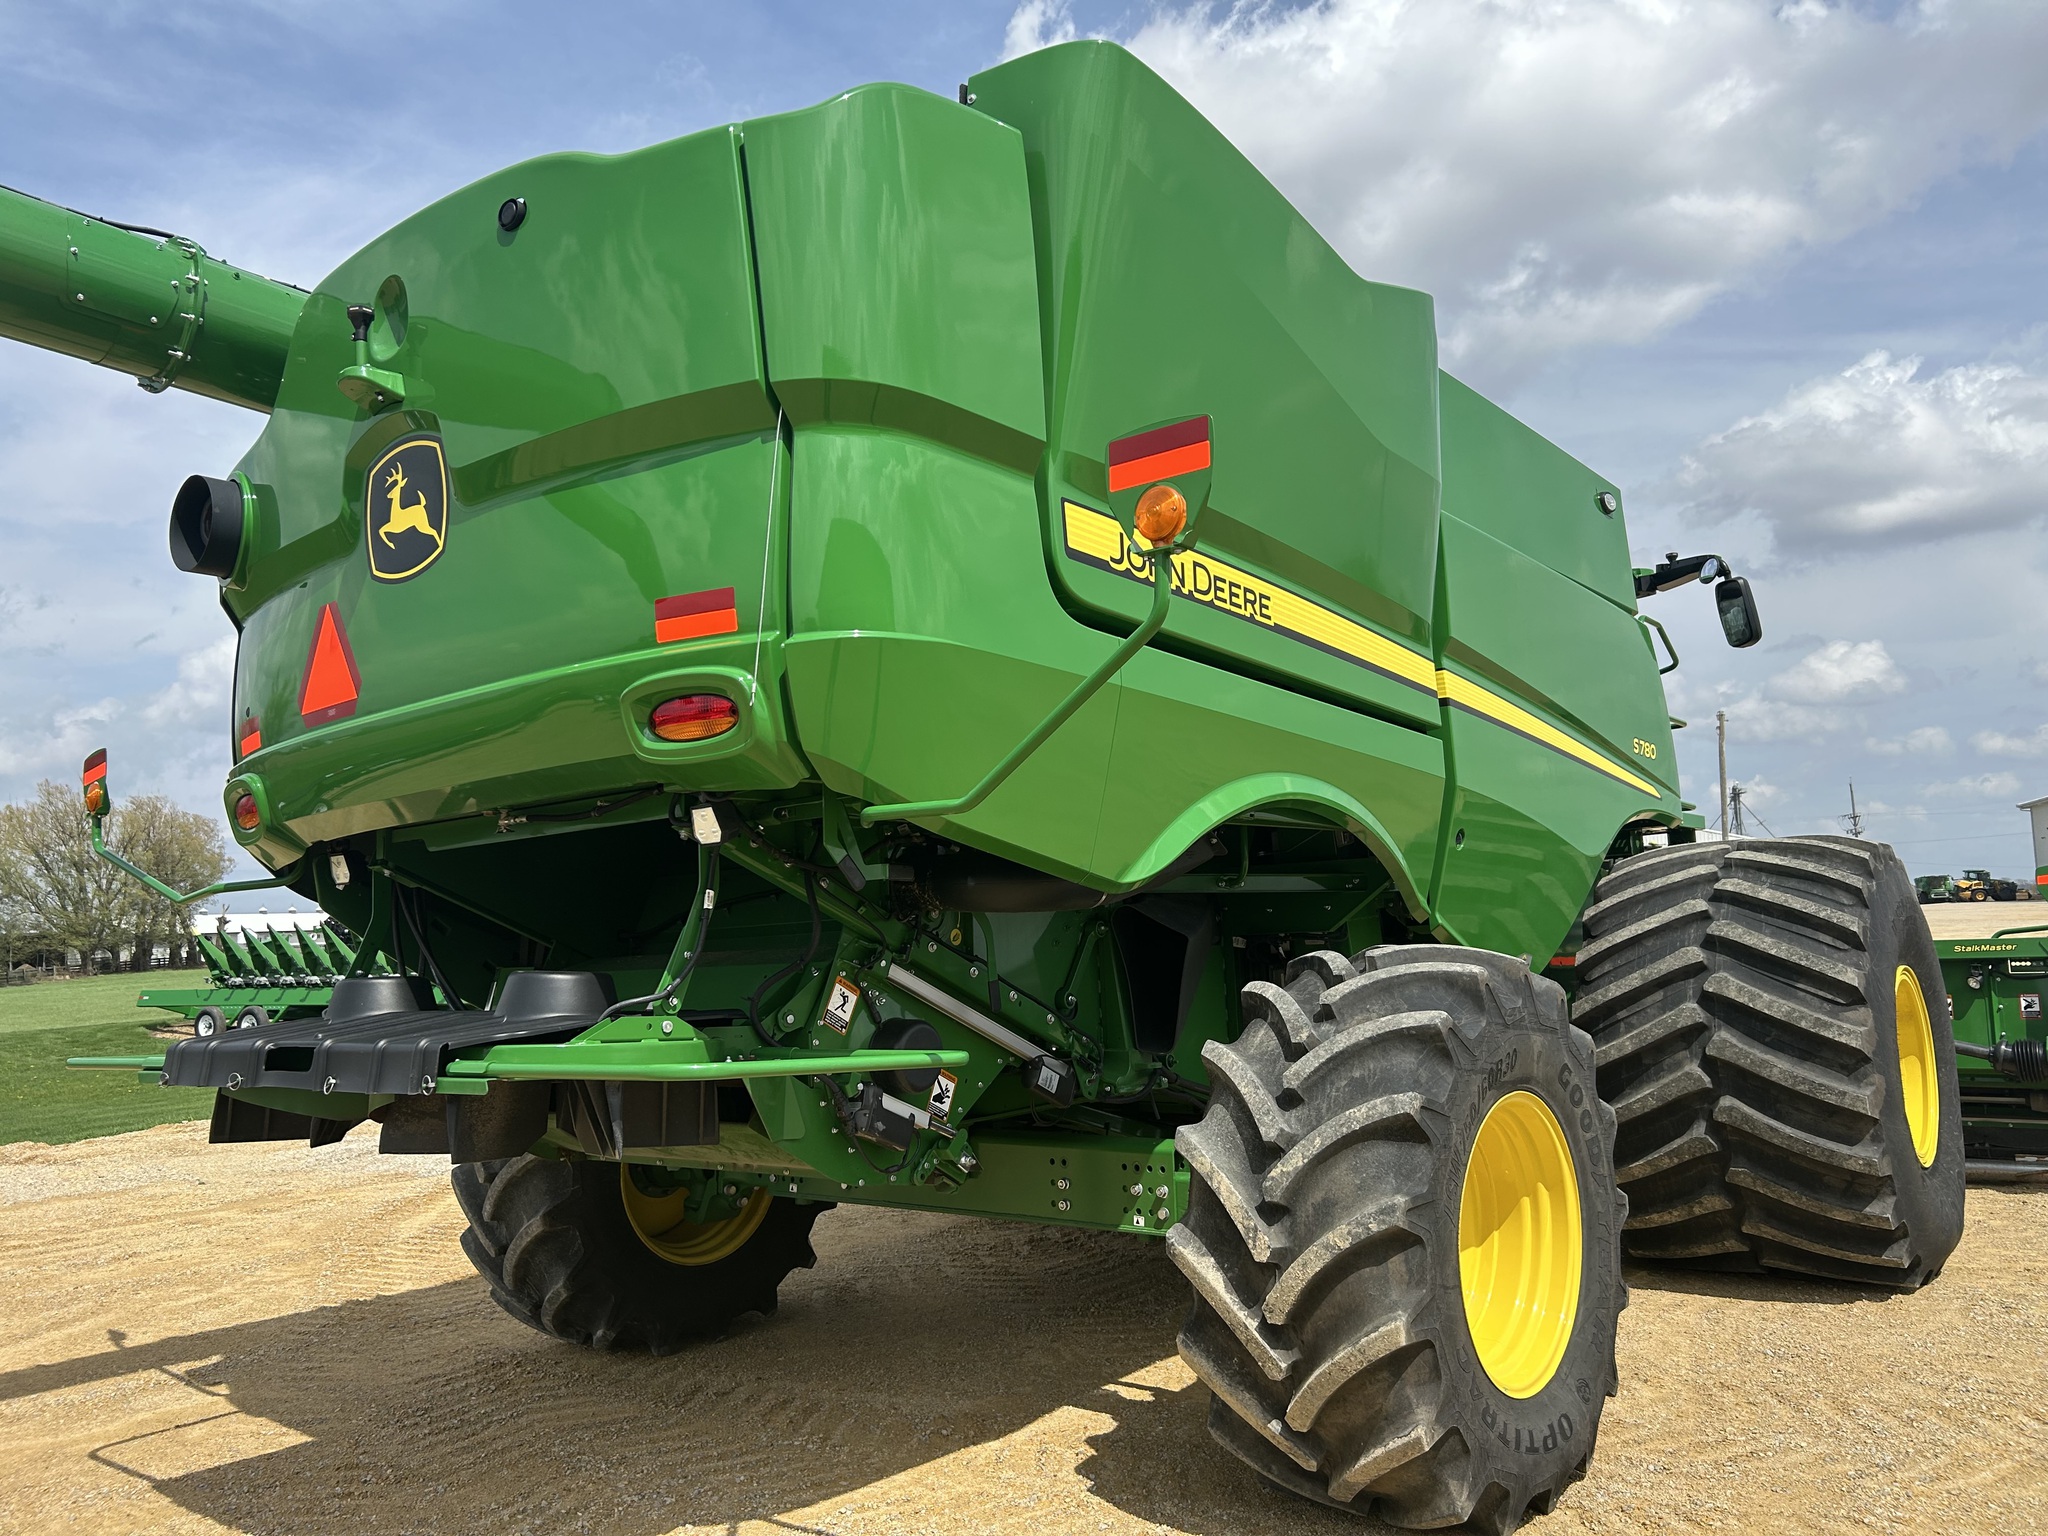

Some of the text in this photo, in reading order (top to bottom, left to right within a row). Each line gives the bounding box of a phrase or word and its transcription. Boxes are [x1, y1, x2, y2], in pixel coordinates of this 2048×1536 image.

[1192, 560, 1272, 621] DEERE
[1633, 737, 1657, 760] S780
[1953, 944, 2018, 953] StalkMaster
[1456, 1345, 1574, 1455] OPTITRAC
